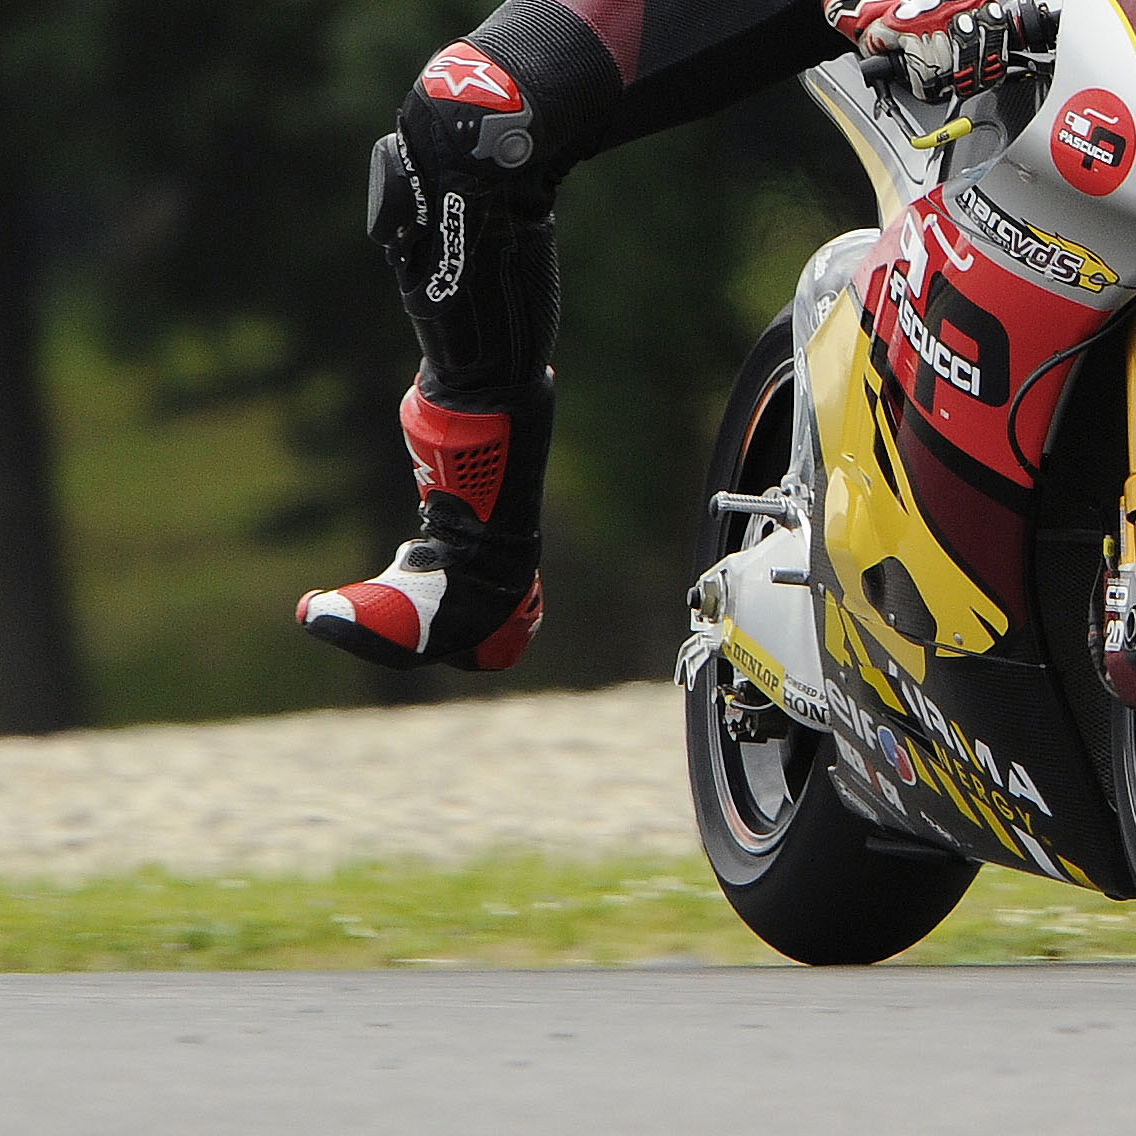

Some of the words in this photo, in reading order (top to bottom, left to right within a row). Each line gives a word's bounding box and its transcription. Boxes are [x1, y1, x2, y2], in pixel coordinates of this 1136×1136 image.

[1058, 129, 1114, 165] PASCUCCI
[733, 642, 780, 693] DUNLOP
[784, 686, 832, 726] HON
[826, 679, 877, 750] elf
[932, 739, 1034, 835] NERGY
